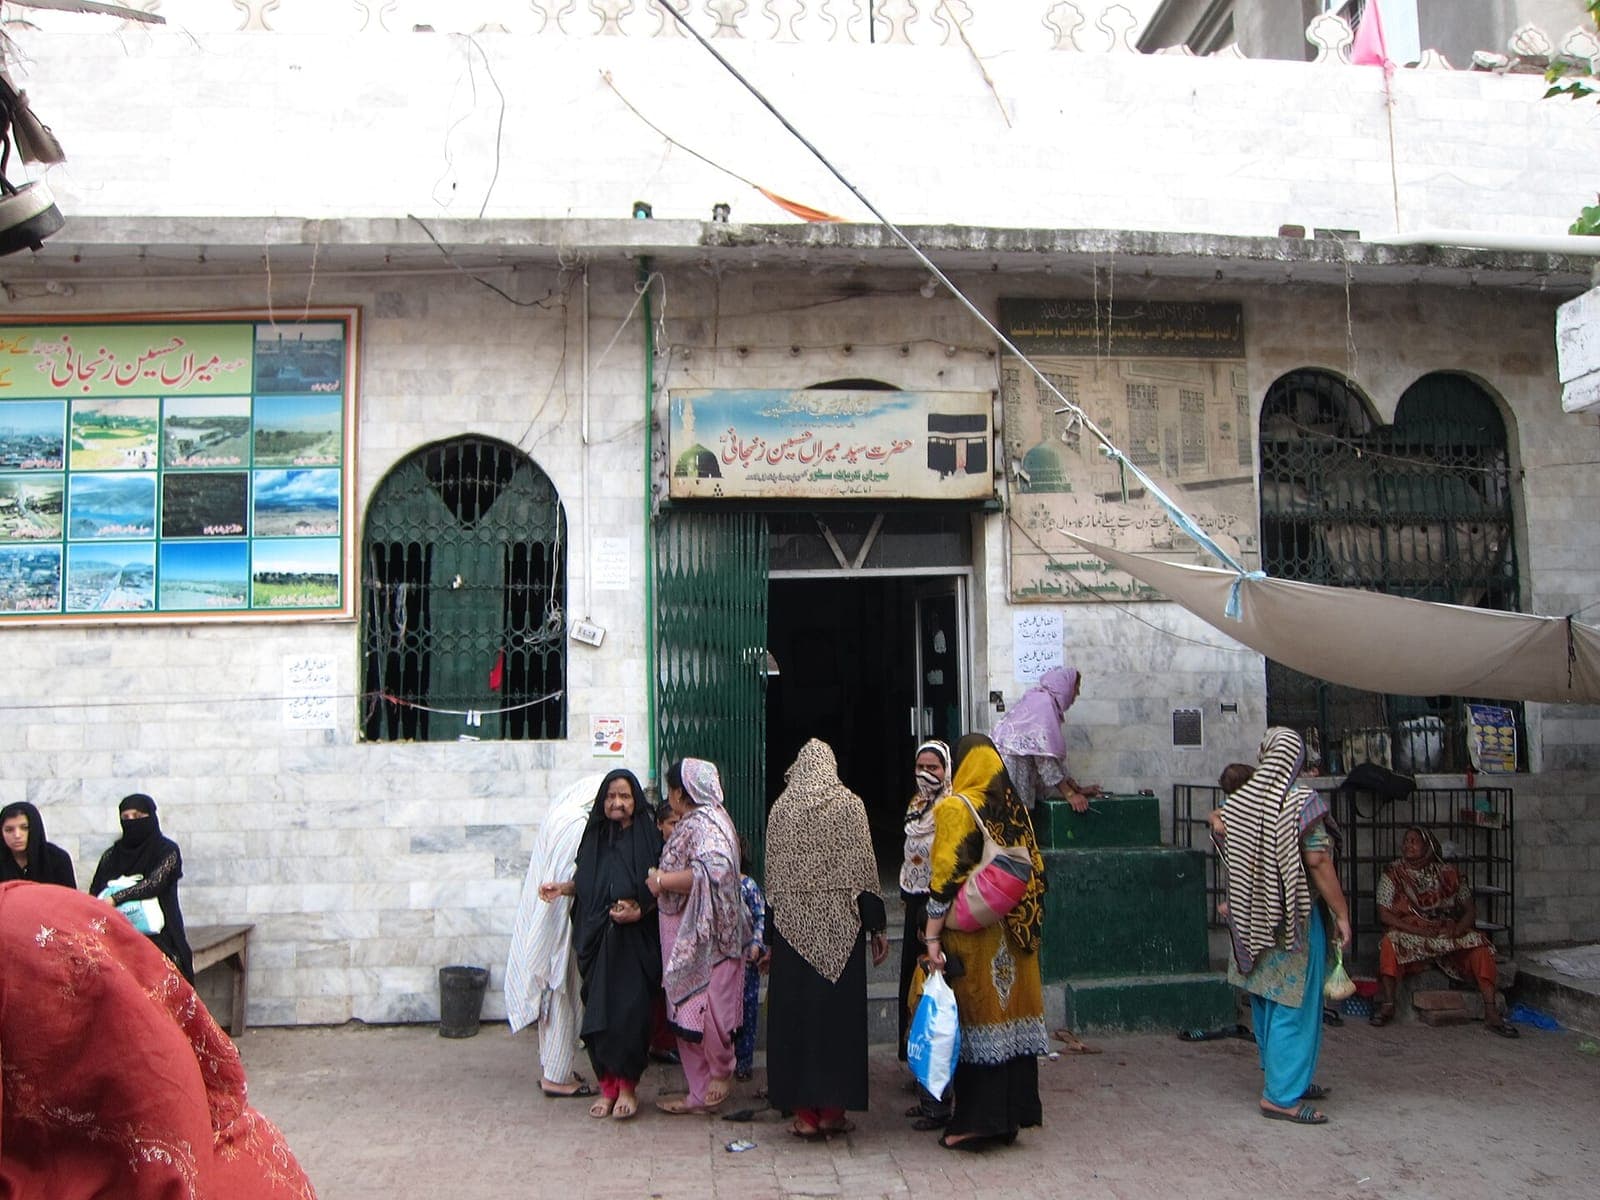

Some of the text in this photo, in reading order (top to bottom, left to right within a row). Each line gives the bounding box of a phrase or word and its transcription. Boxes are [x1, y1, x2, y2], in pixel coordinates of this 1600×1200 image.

[50, 334, 115, 393] زنجانی
[115, 336, 185, 388] حسین
[160, 351, 220, 391] میراں
[766, 430, 813, 466] حسین
[799, 439, 840, 468] میراں
[841, 444, 867, 465] سید
[865, 438, 914, 467] حضرت
[1071, 580, 1120, 598] حسین
